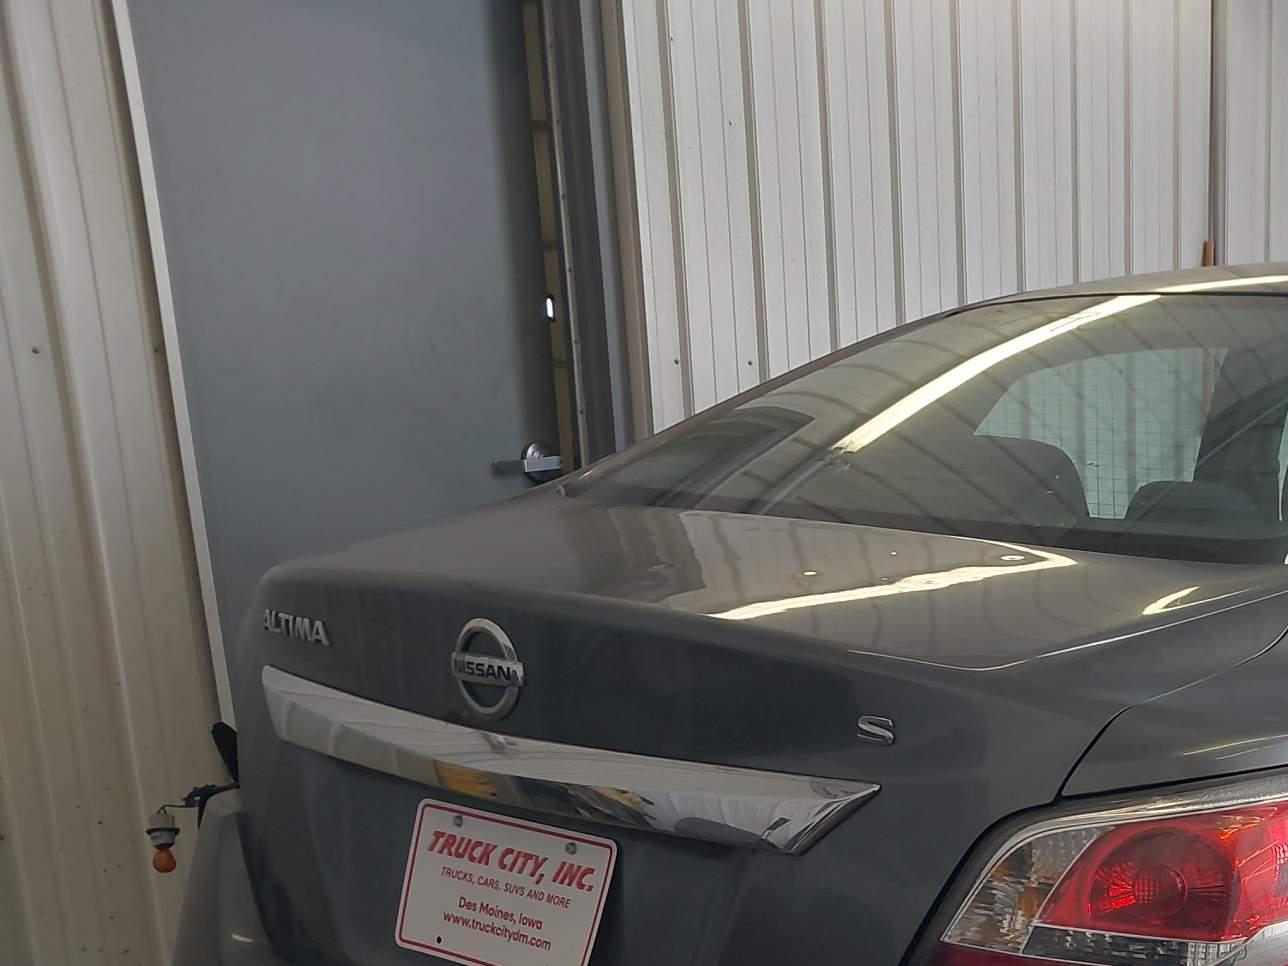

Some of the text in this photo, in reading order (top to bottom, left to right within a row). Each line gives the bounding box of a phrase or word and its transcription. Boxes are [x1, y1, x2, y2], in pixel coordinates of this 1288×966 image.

[263, 608, 330, 647] ALTIMA
[455, 659, 520, 684] NISSAN
[857, 715, 894, 744] S
[427, 830, 595, 892] TRUCK CITY, INC.
[441, 866, 475, 886] TRUCKS,
[503, 882, 525, 897] SUVS
[527, 889, 545, 902] AND
[546, 893, 572, 909] MORE
[443, 911, 552, 951] www.truckcitydm.com
[458, 896, 543, 930] Des Moines, Iowa
